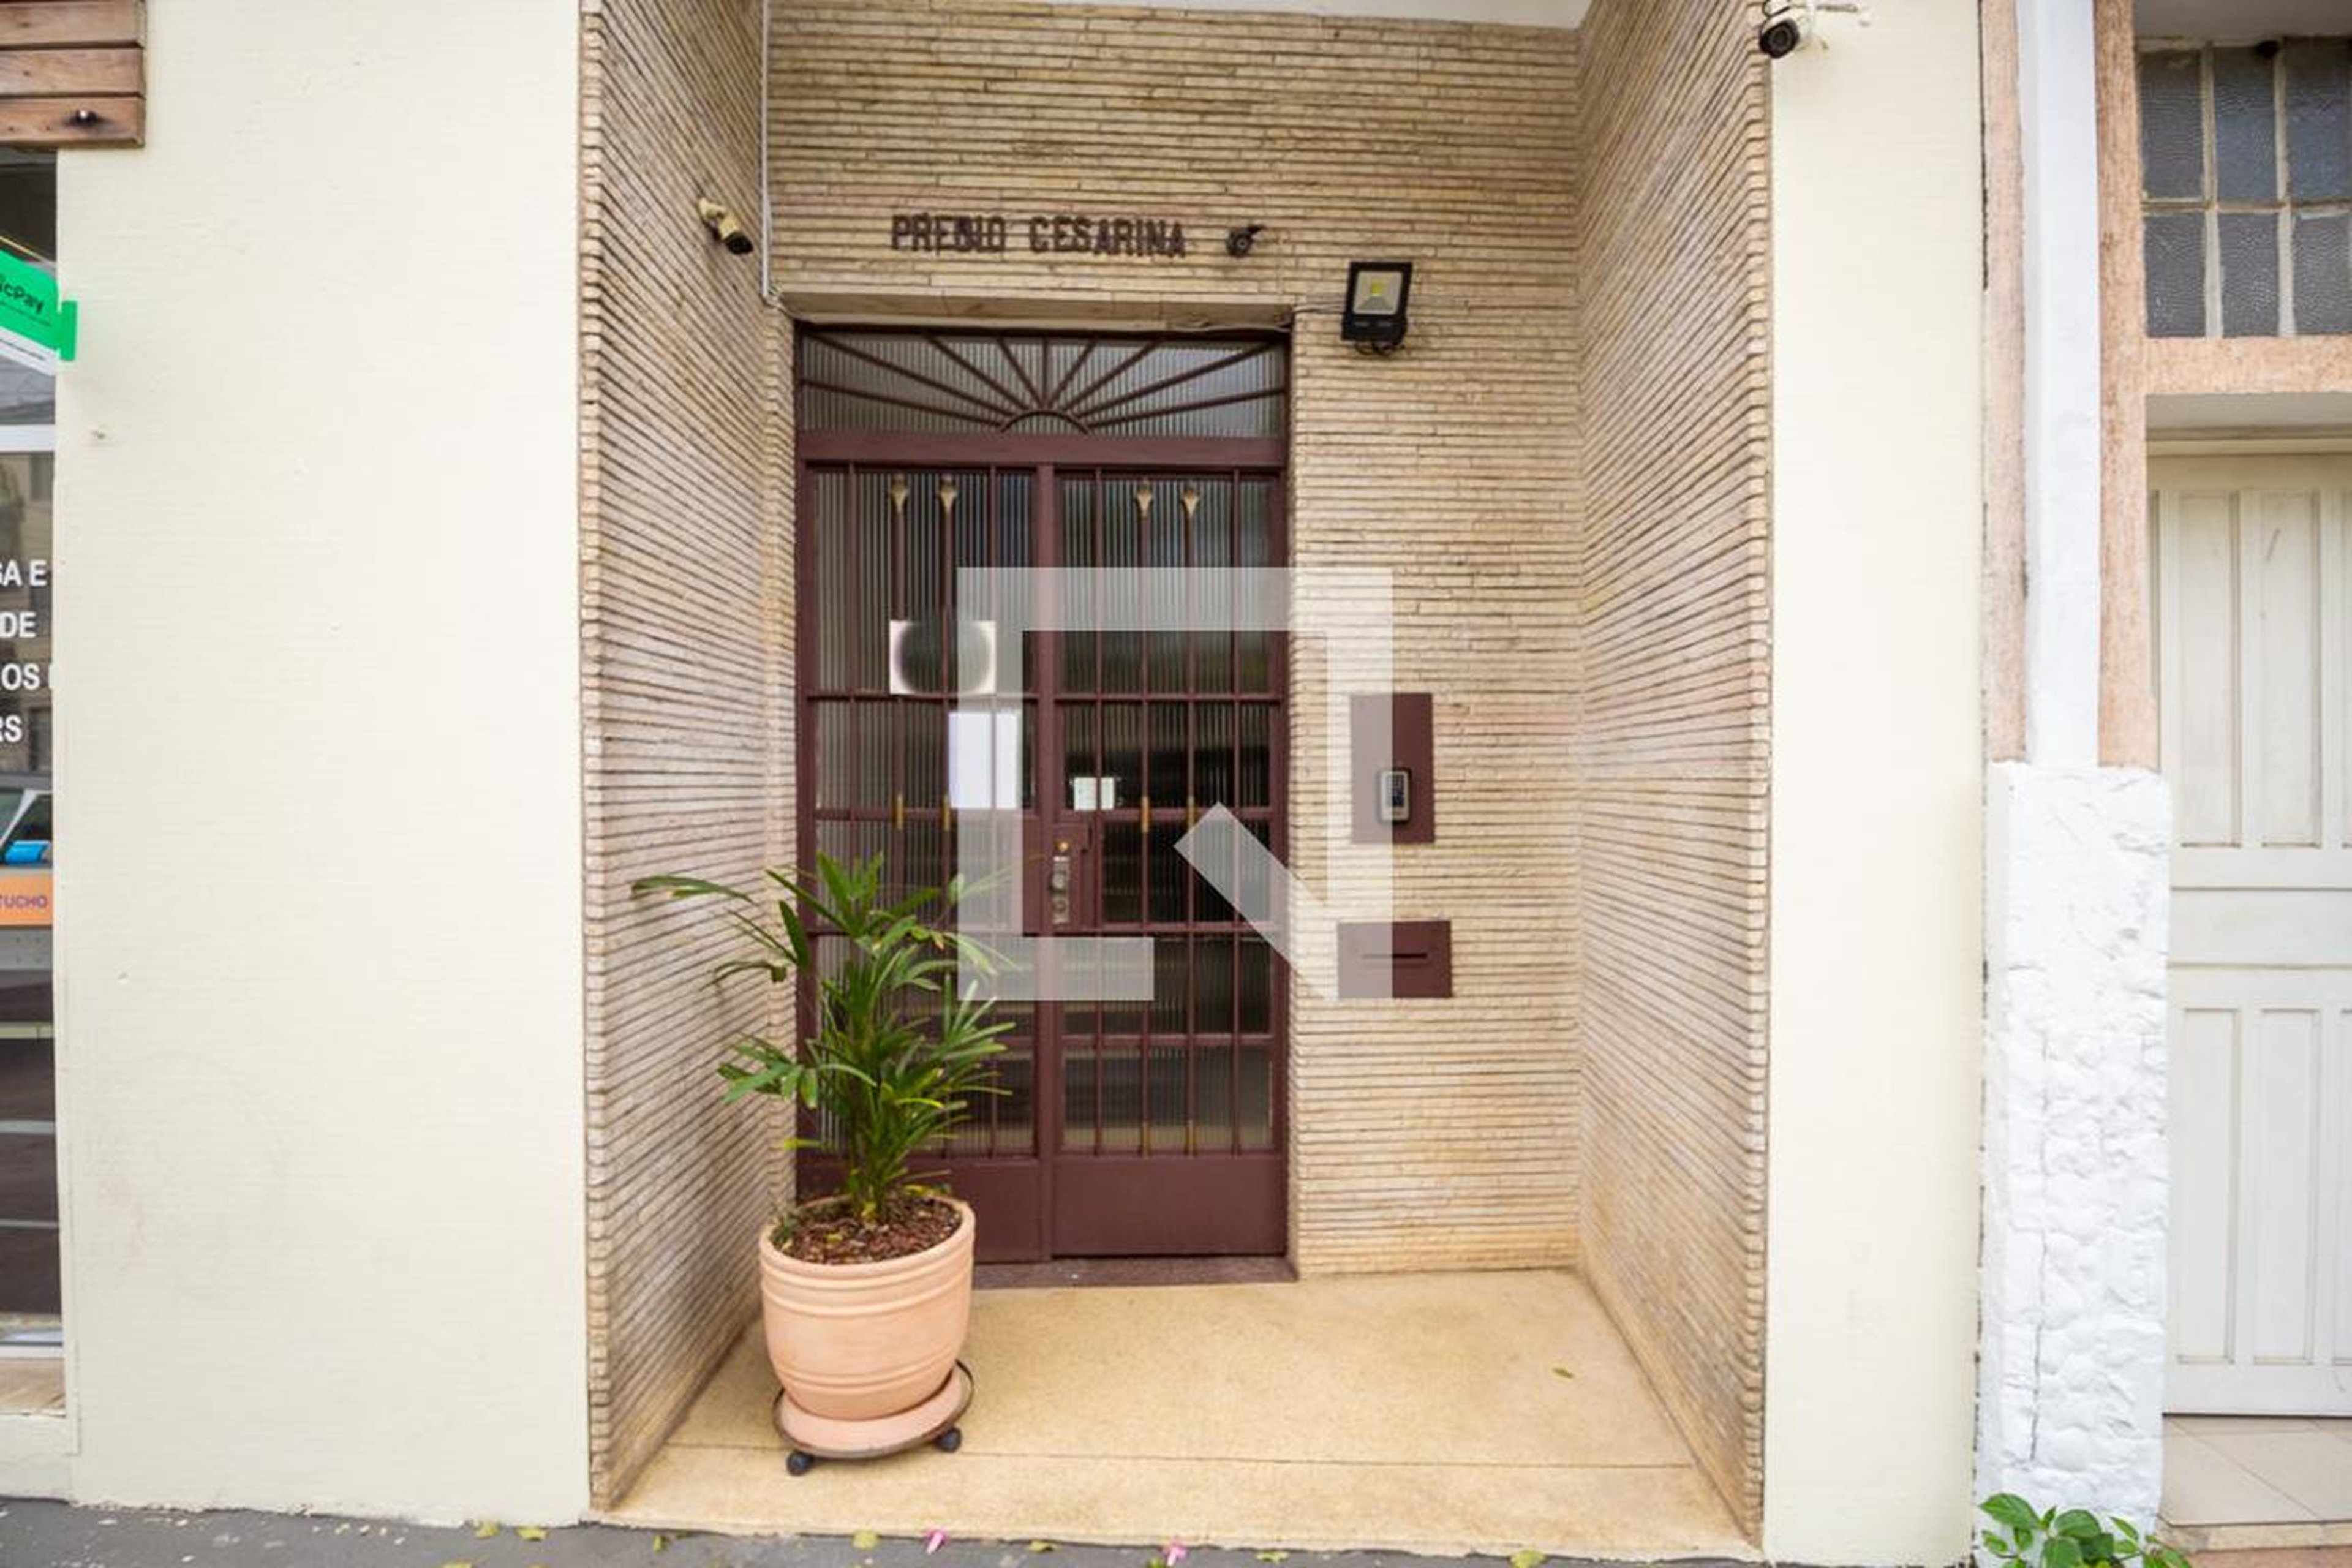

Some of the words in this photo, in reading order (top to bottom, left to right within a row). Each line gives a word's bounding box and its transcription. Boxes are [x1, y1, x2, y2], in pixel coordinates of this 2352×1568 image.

[1030, 216, 1186, 257] CESARINA
[29, 560, 47, 586] E
[0, 895, 48, 909] UCHO
